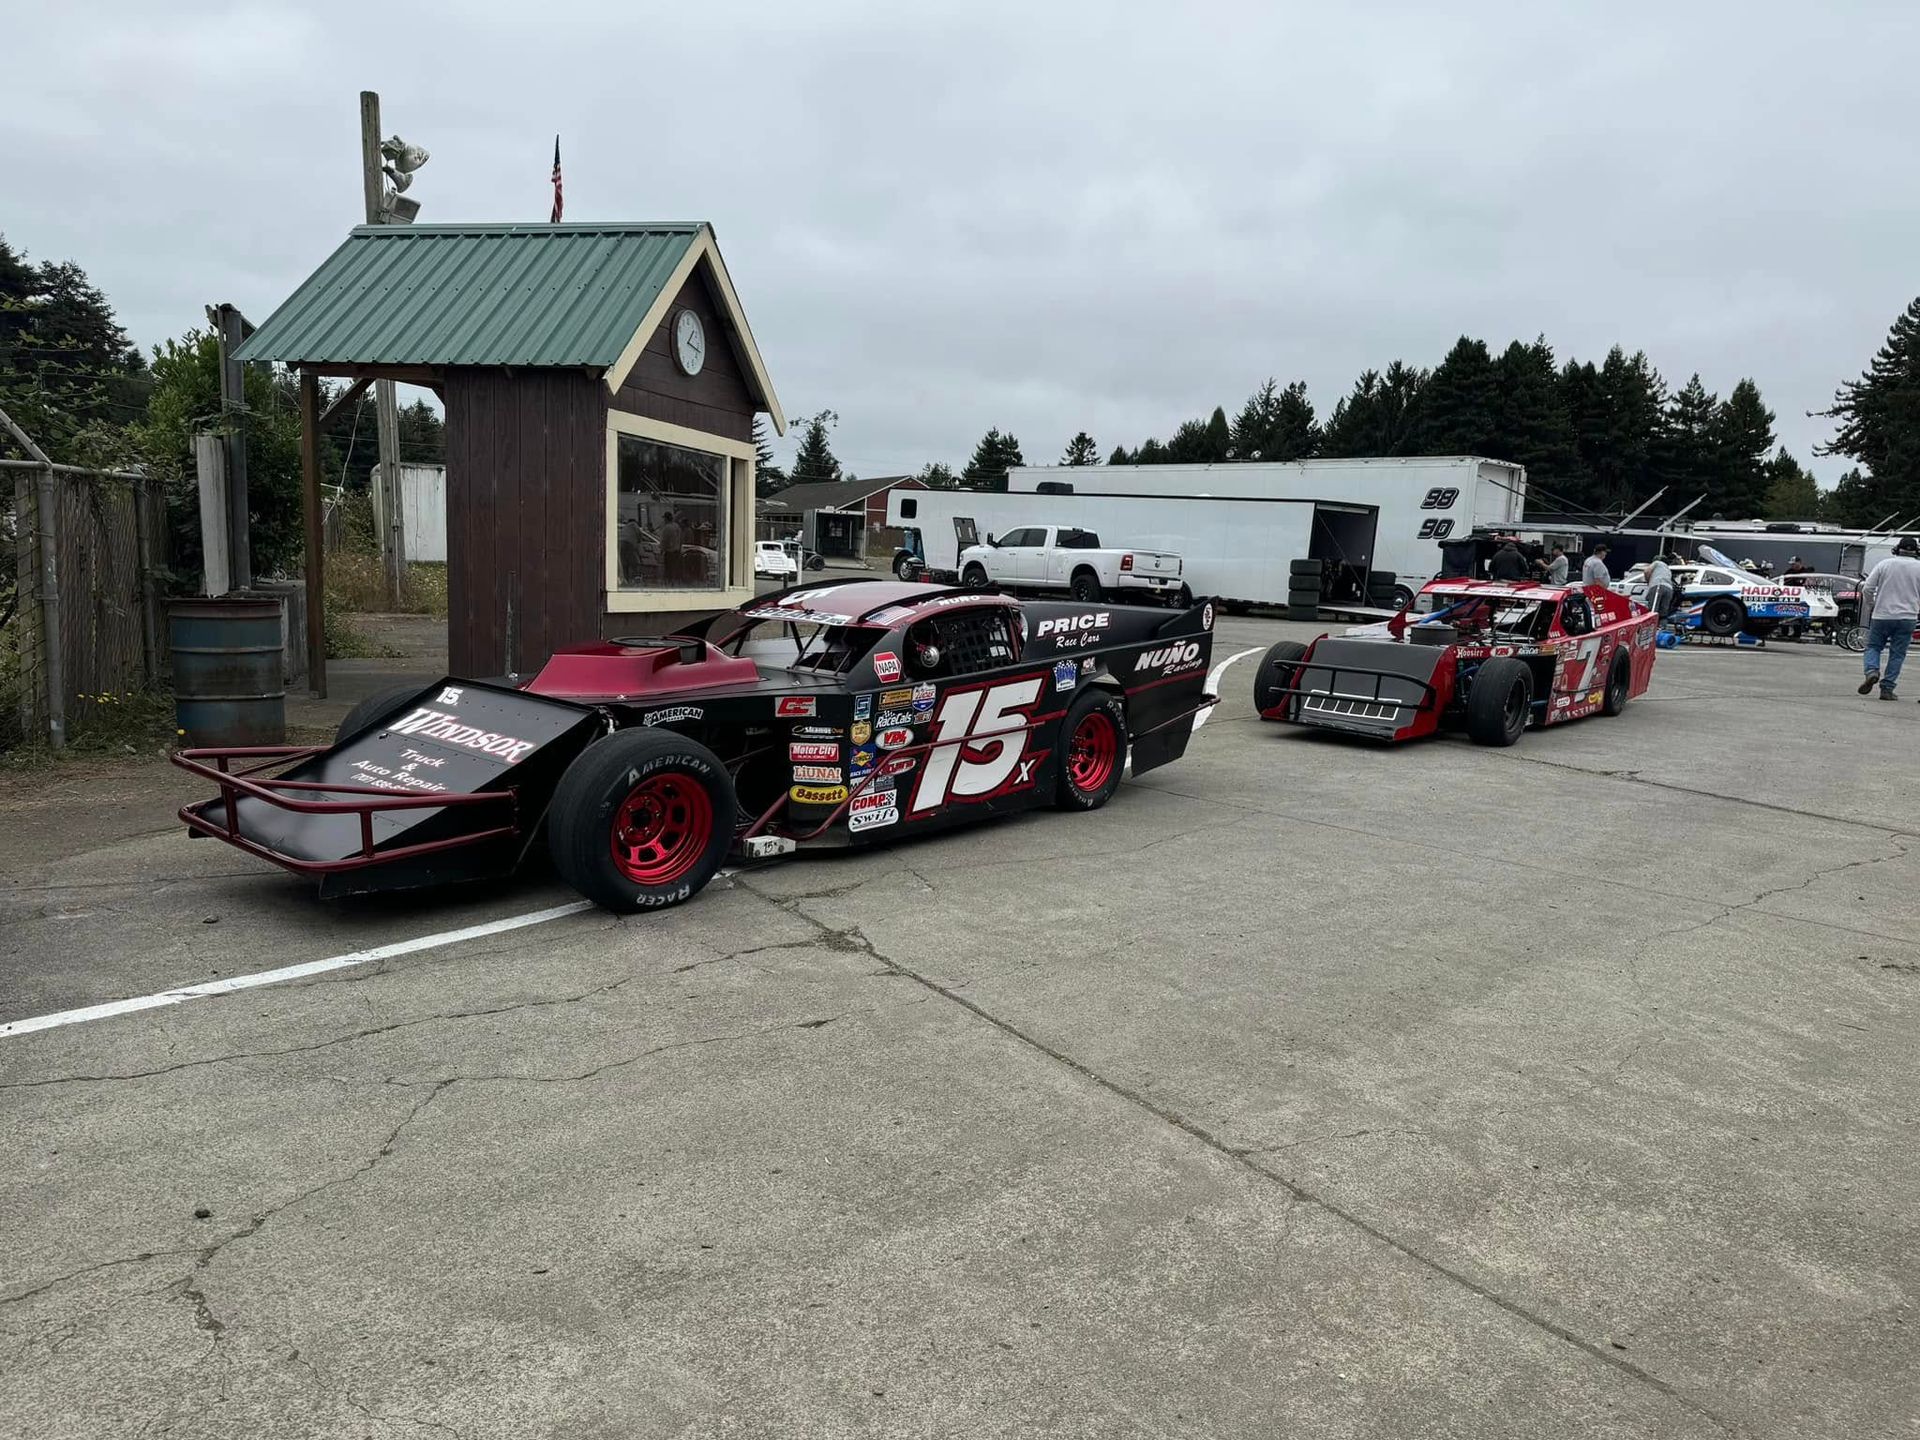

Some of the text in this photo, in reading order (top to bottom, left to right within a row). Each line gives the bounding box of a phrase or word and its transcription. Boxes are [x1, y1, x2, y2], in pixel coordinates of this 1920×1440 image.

[1420, 487, 1459, 509] 98
[1417, 518, 1455, 539] 90
[1741, 586, 1801, 596] HADAD
[1037, 612, 1111, 637] PRICE
[1055, 632, 1100, 649] Race Cars
[1134, 640, 1199, 671] NUÑO
[1456, 645, 1484, 659] Hoosier
[878, 660, 898, 675] NAPA
[1574, 636, 1602, 703] 7
[650, 707, 703, 725] AMERICAN
[876, 712, 912, 729] RaceCals
[387, 708, 537, 763] WINDSOR
[912, 678, 1044, 812] 15
[401, 748, 445, 769] Truck
[793, 745, 837, 757] Motor City
[352, 760, 391, 776] Auto
[392, 771, 446, 792] Repair
[402, 762, 418, 772] &
[628, 754, 711, 786] AMERICAN
[796, 789, 843, 801] Bassett
[852, 793, 886, 811] COMP
[852, 808, 895, 826] Swift
[636, 884, 690, 906] RACER
